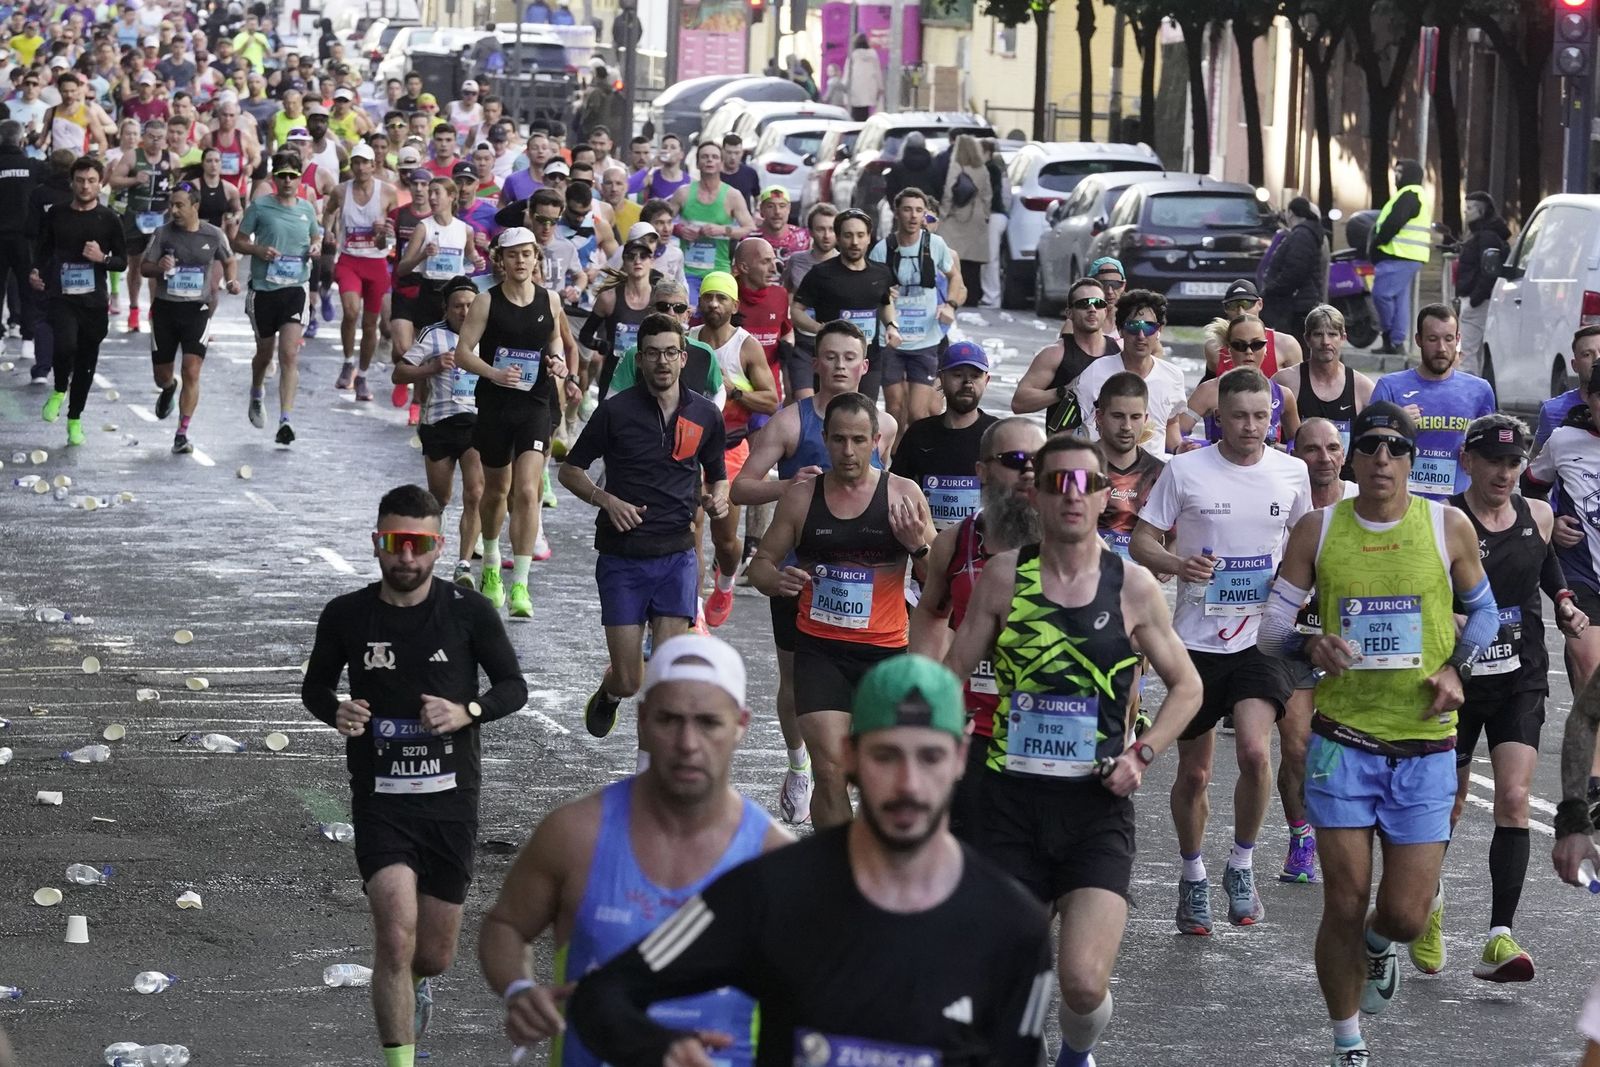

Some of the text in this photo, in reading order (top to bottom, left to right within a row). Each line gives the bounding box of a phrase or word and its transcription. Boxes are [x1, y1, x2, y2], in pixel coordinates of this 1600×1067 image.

[511, 351, 536, 360] ZURICH
[1423, 449, 1451, 458] ZURICH
[1422, 463, 1438, 471] 6145
[941, 479, 973, 487] ZURICH
[1408, 471, 1450, 484] RICARDO
[929, 505, 976, 518] THIBAULT
[1230, 559, 1266, 569] ZURICH
[831, 569, 866, 581] ZURICH
[1231, 578, 1251, 586] 9315
[1219, 589, 1260, 602] PAWEL
[818, 594, 863, 614] PALACIO
[1367, 600, 1412, 612] ZURICH
[1307, 613, 1321, 626] GU
[1369, 622, 1392, 633] 6274
[1364, 636, 1400, 652] FEDE
[1481, 643, 1513, 660] VIER
[973, 660, 995, 676] EL
[1038, 699, 1087, 713] ZURICH
[401, 724, 427, 735] ZUR
[1038, 724, 1064, 735] 6192
[402, 745, 428, 757] 5270
[1023, 737, 1078, 757] FRANK
[390, 758, 441, 776] ALLAN
